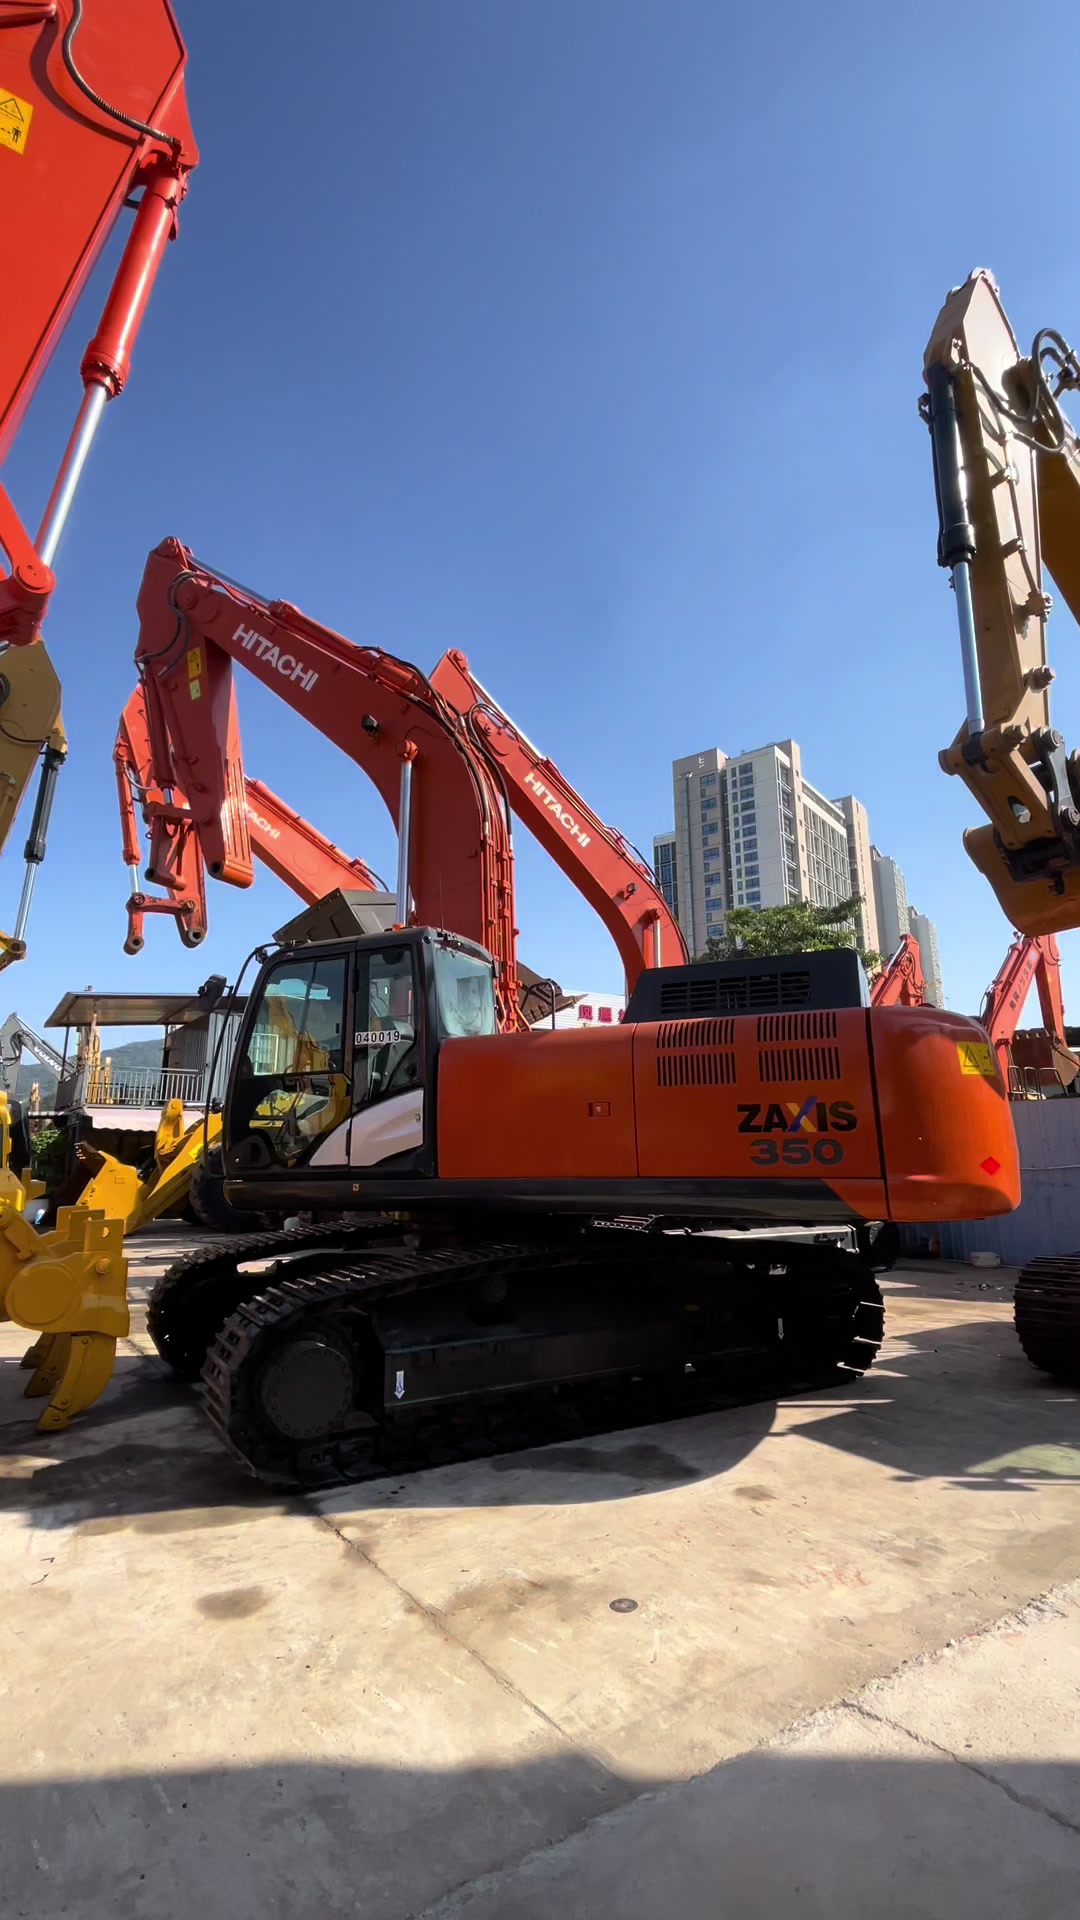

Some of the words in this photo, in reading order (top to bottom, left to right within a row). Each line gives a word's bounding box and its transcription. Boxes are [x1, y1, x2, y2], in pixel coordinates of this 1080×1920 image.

[232, 623, 319, 692] HITACHI
[524, 772, 591, 848] HITACHI
[356, 1031, 400, 1043] 040019
[34, 1046, 63, 1072] VOLVO
[737, 1095, 858, 1133] ZAXIS
[750, 1138, 844, 1166] 350
